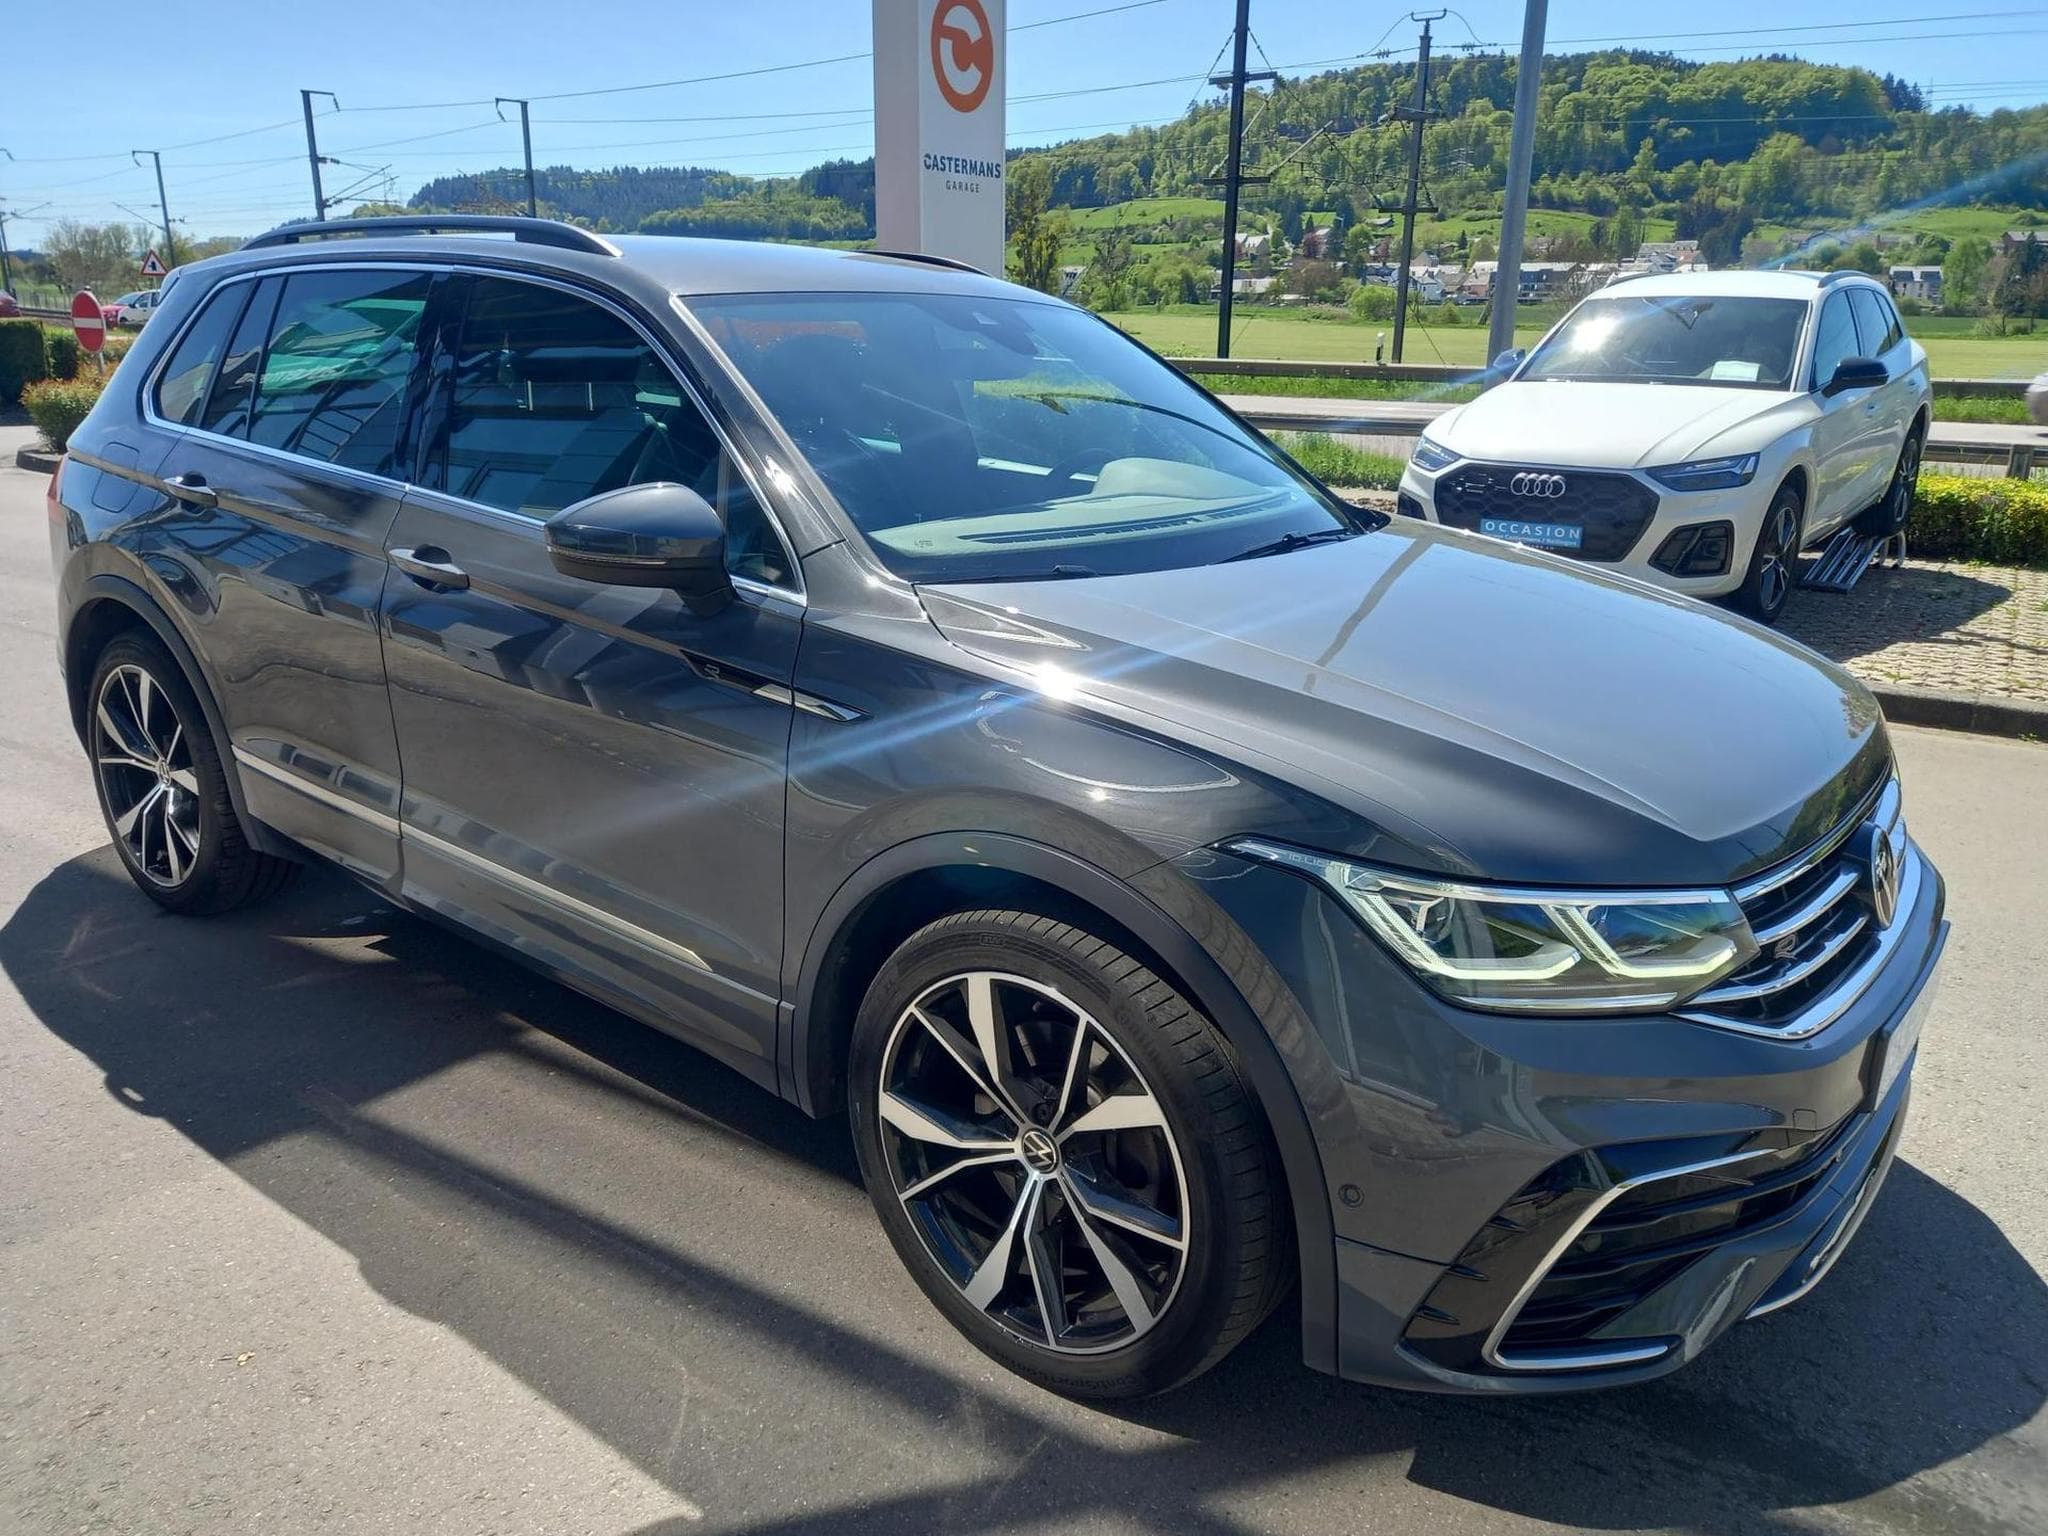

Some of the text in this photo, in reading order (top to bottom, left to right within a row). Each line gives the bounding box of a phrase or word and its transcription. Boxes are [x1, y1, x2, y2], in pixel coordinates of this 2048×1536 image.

[923, 153, 1001, 179] CASTERMANS
[945, 180, 980, 194] GARAGE
[1485, 521, 1580, 539] OCCASION
